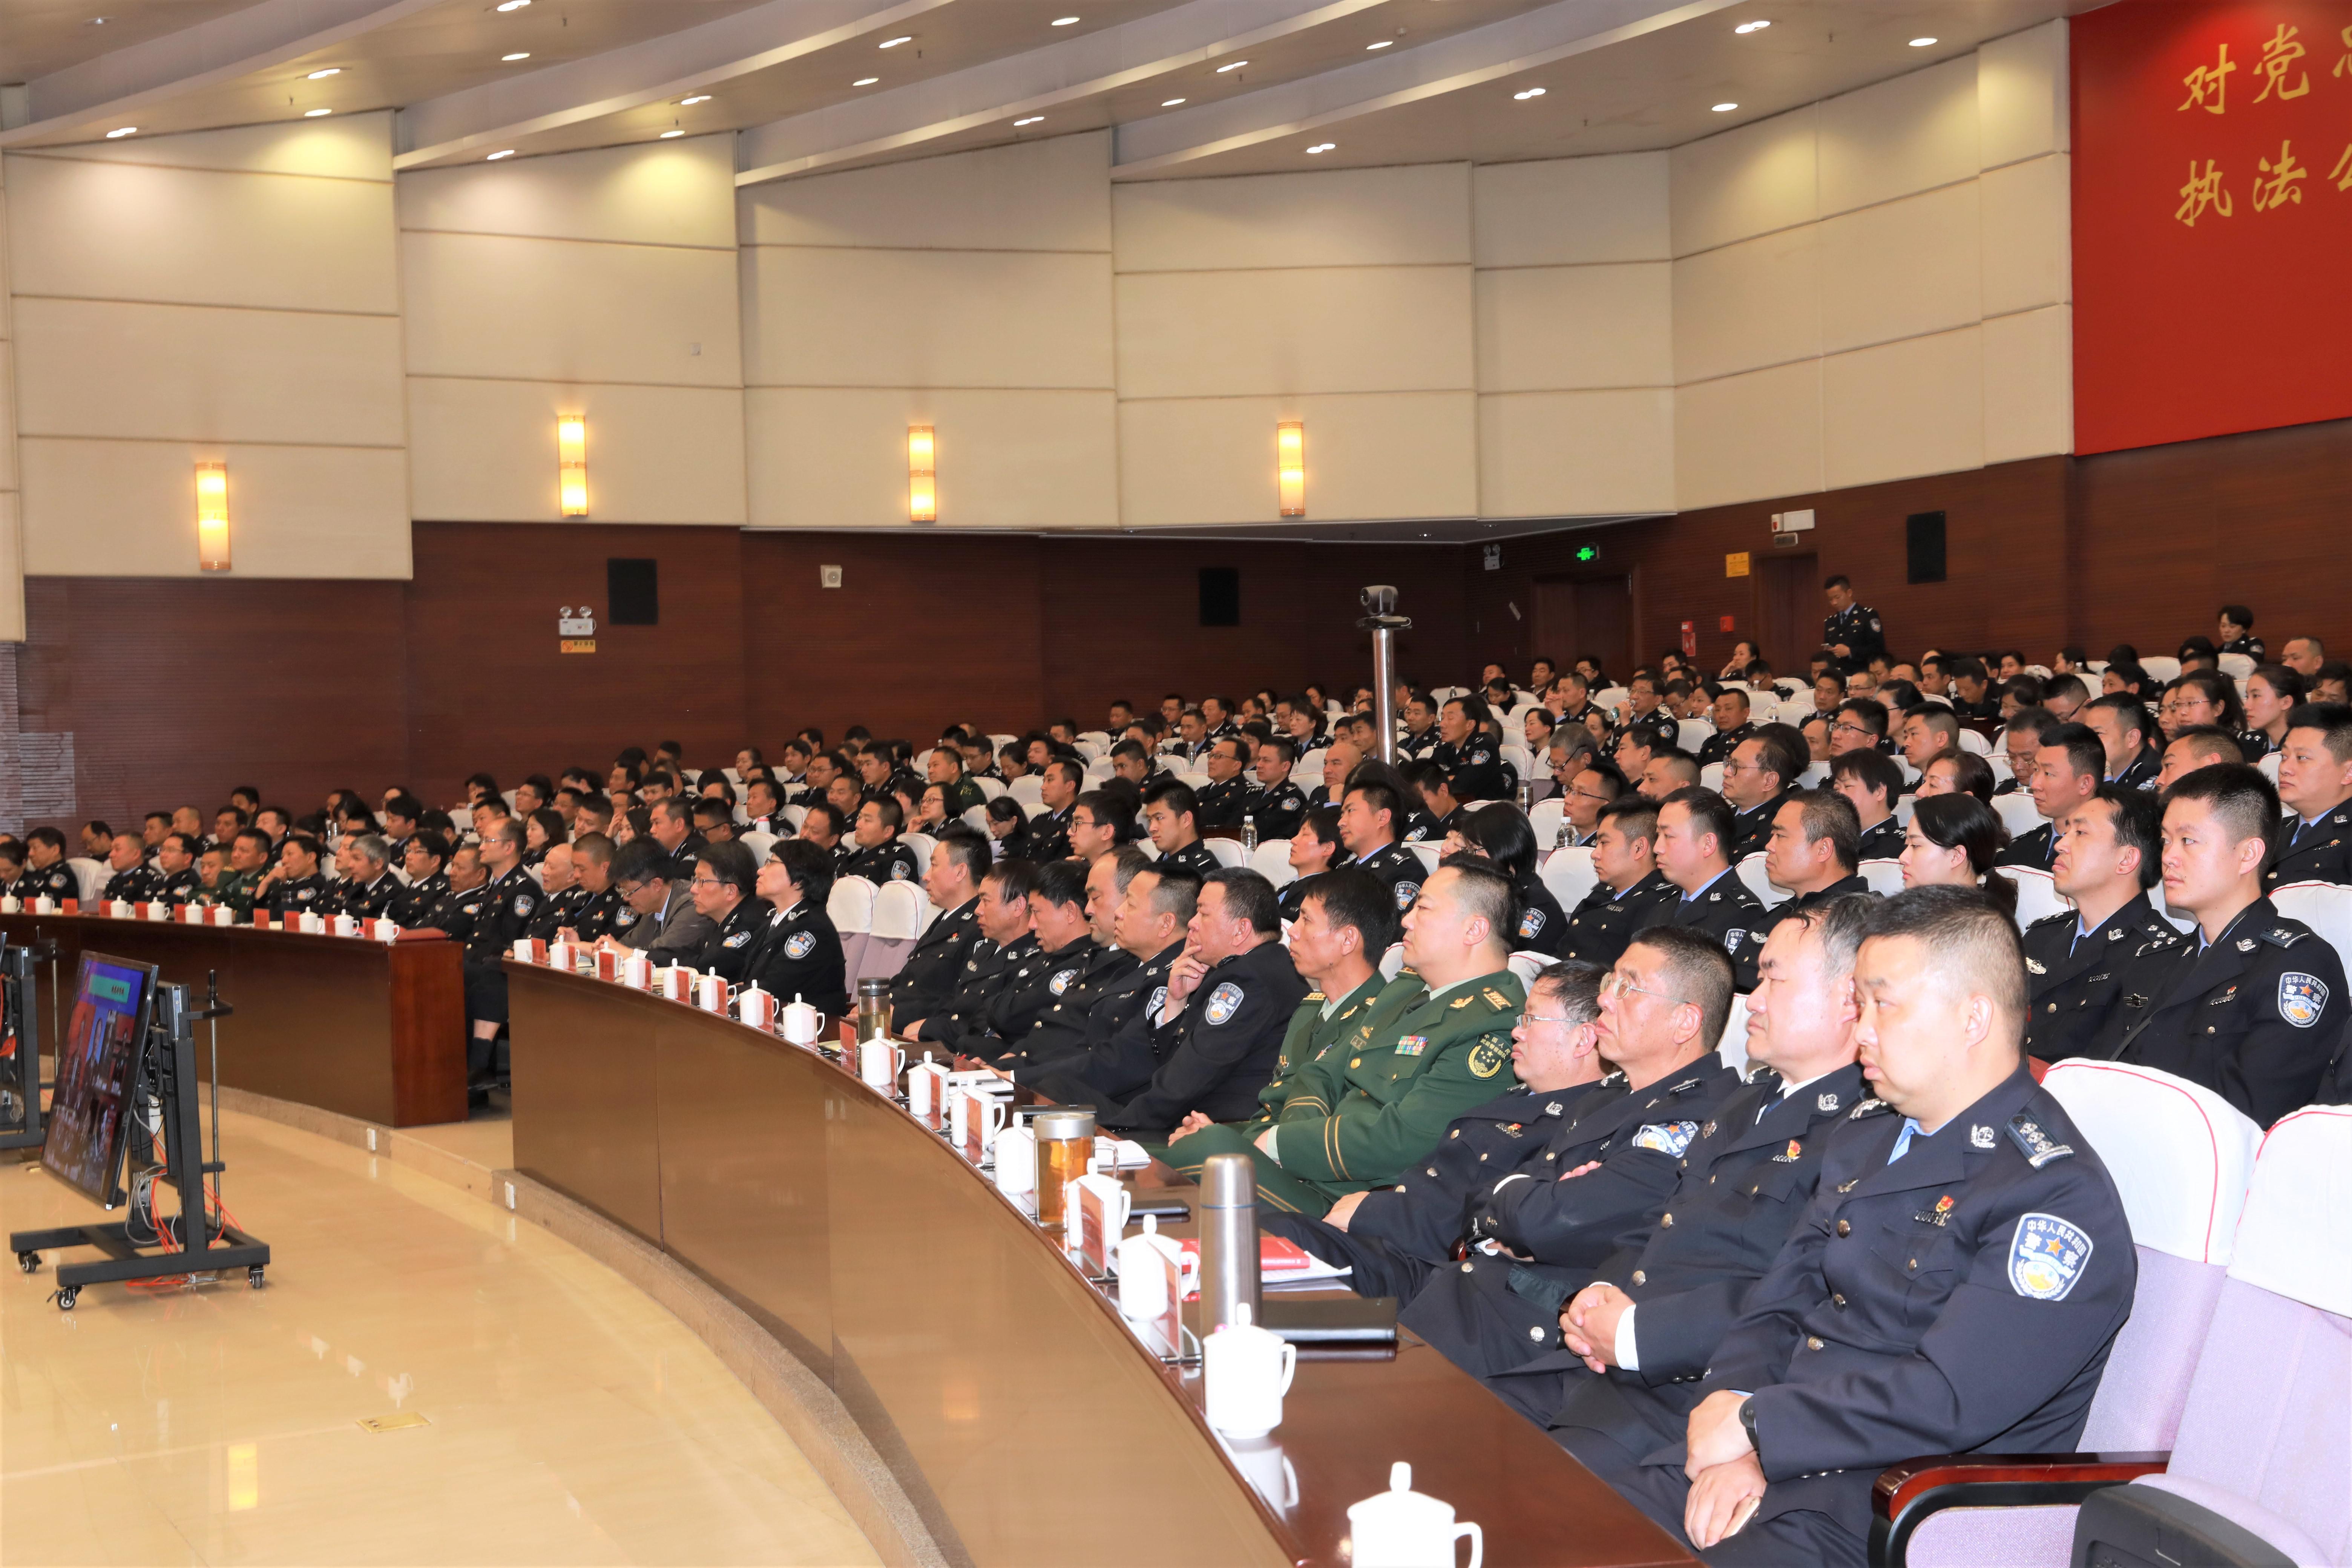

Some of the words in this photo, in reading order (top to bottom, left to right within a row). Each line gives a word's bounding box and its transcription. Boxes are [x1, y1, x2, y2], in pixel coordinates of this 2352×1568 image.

[2285, 975, 2326, 997] 中华人民共和国
[2285, 984, 2297, 994] 警
[2312, 992, 2322, 1004] 察
[1484, 1034, 1511, 1055] 中国人民
[2027, 1220, 2087, 1257] 中华人民共和国
[2062, 1249, 2079, 1268] 察
